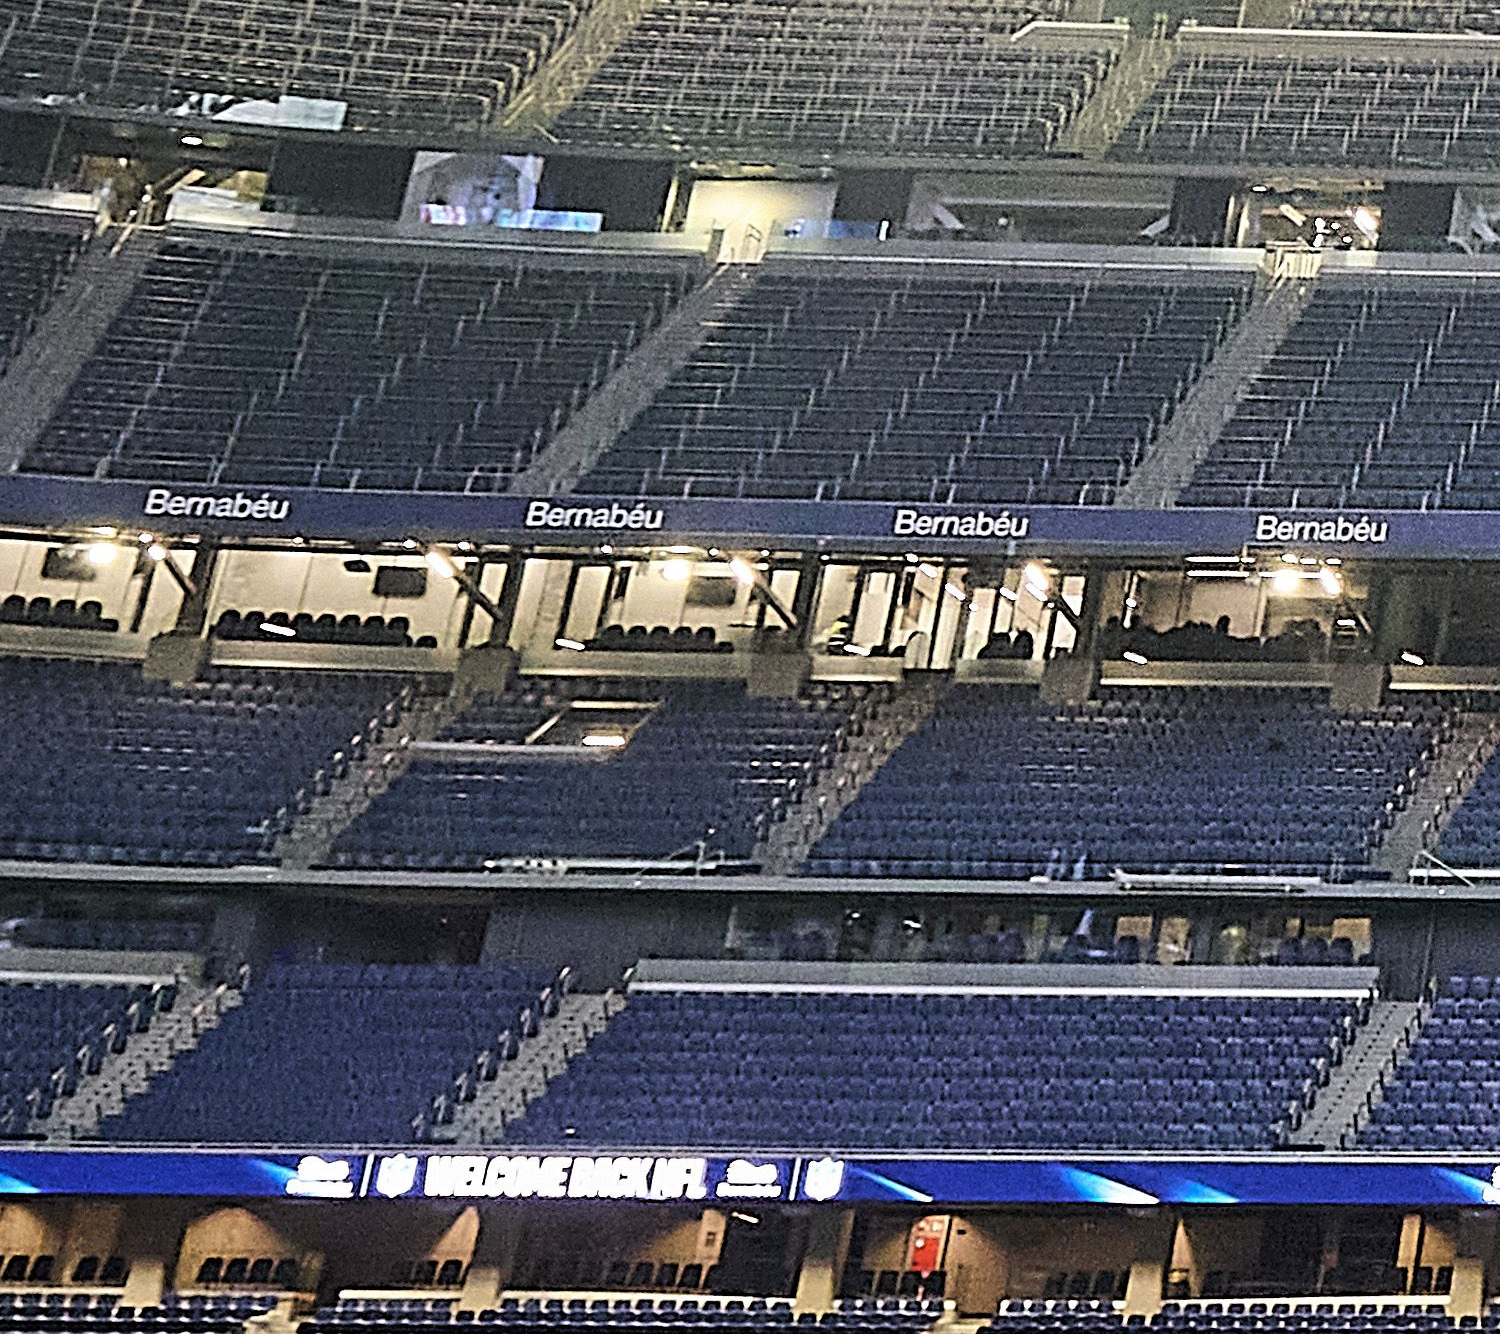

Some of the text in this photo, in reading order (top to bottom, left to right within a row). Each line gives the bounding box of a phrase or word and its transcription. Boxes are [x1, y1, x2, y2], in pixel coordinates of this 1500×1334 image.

[144, 488, 290, 520] Bernabéu
[525, 500, 664, 529] Bernabéu
[893, 508, 1029, 537] Bernabéu
[1255, 513, 1388, 542] Bernabéu
